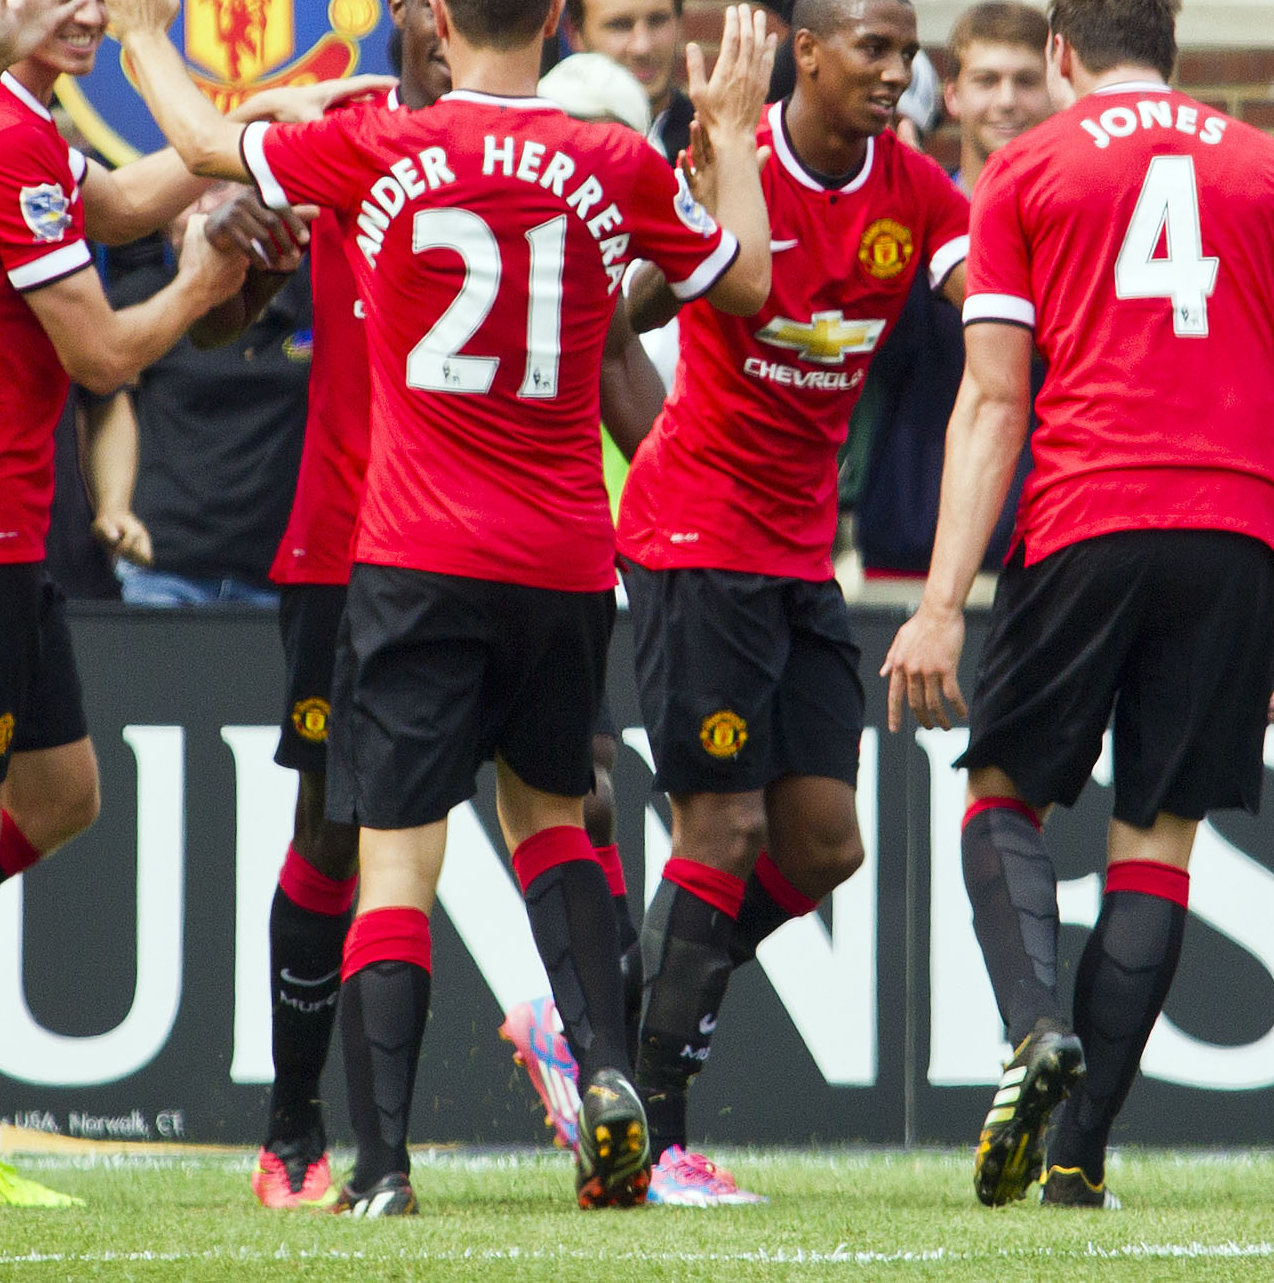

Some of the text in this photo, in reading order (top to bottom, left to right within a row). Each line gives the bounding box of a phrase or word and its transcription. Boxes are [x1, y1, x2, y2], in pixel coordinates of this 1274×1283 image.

[1080, 100, 1227, 149] JONES
[356, 134, 631, 296] ANDER HERRERA
[1114, 154, 1220, 338] 4
[406, 206, 567, 400] 21
[743, 356, 864, 391] CHEVROL
